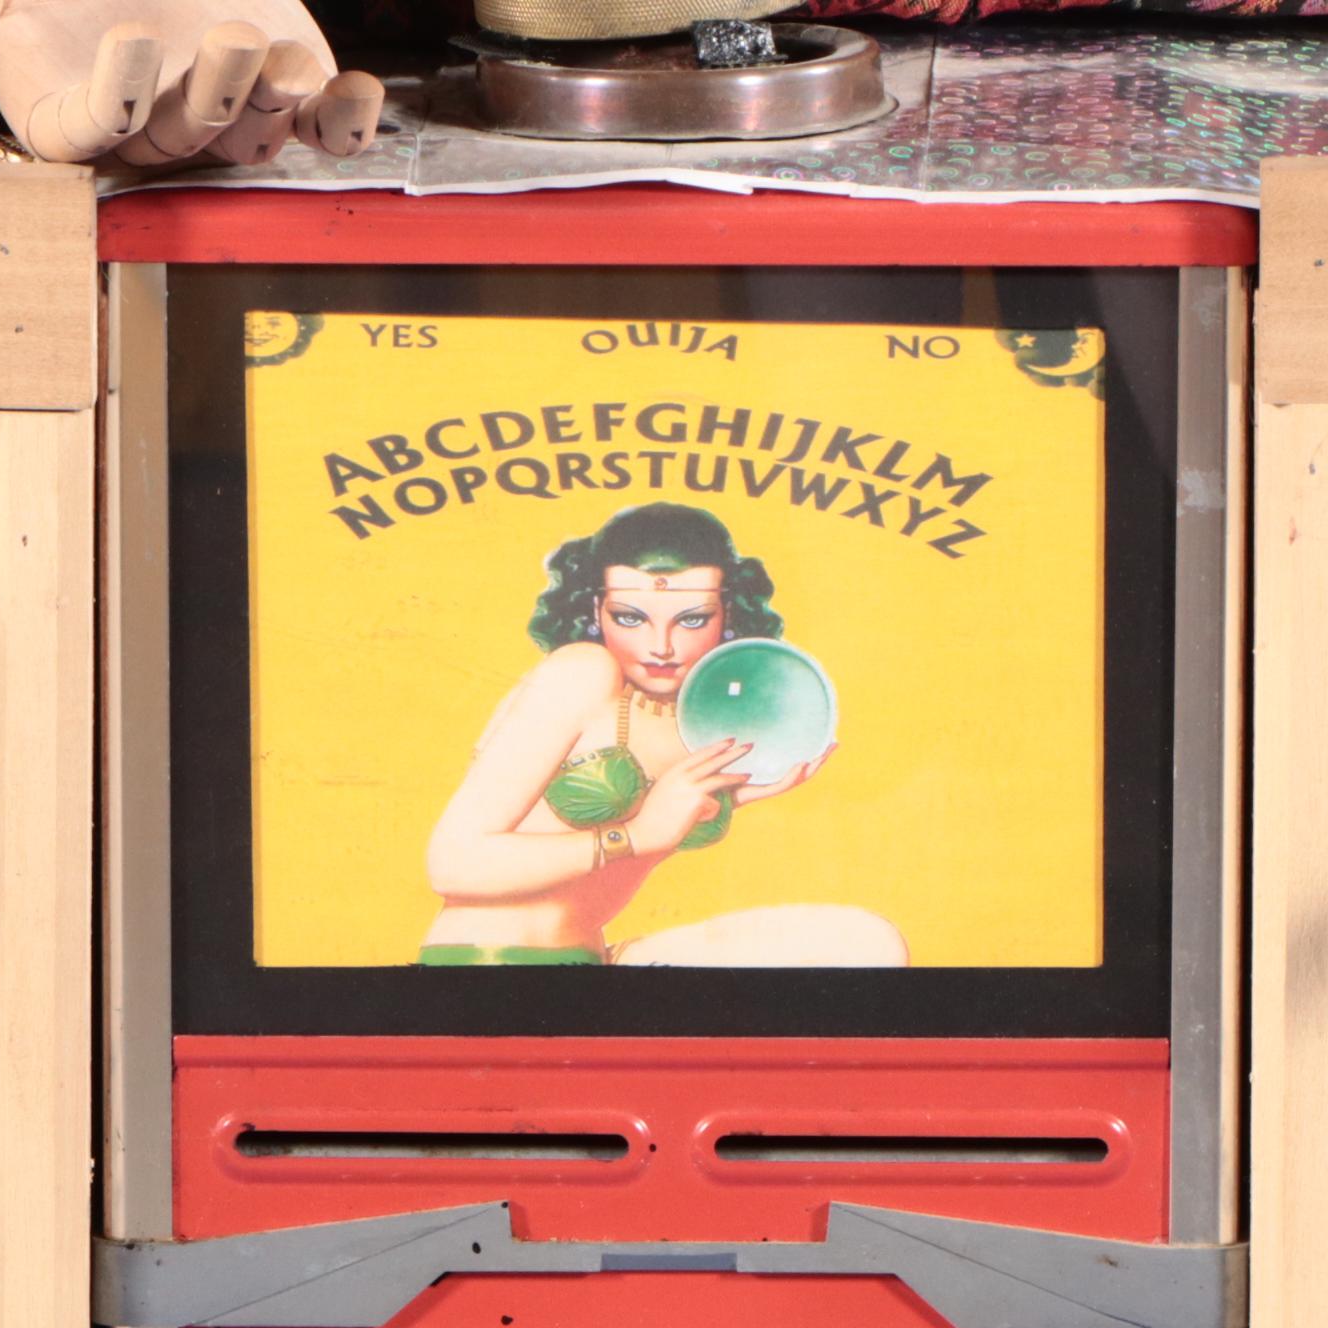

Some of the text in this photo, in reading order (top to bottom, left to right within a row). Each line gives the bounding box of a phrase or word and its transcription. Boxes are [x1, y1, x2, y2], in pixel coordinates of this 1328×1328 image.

[358, 321, 439, 351] YES
[580, 320, 739, 362] OUIJA
[885, 333, 962, 361] NO
[322, 401, 995, 508] ABCDEFGHIJKLM
[328, 449, 990, 560] NOPQRSTUVWXYZ
